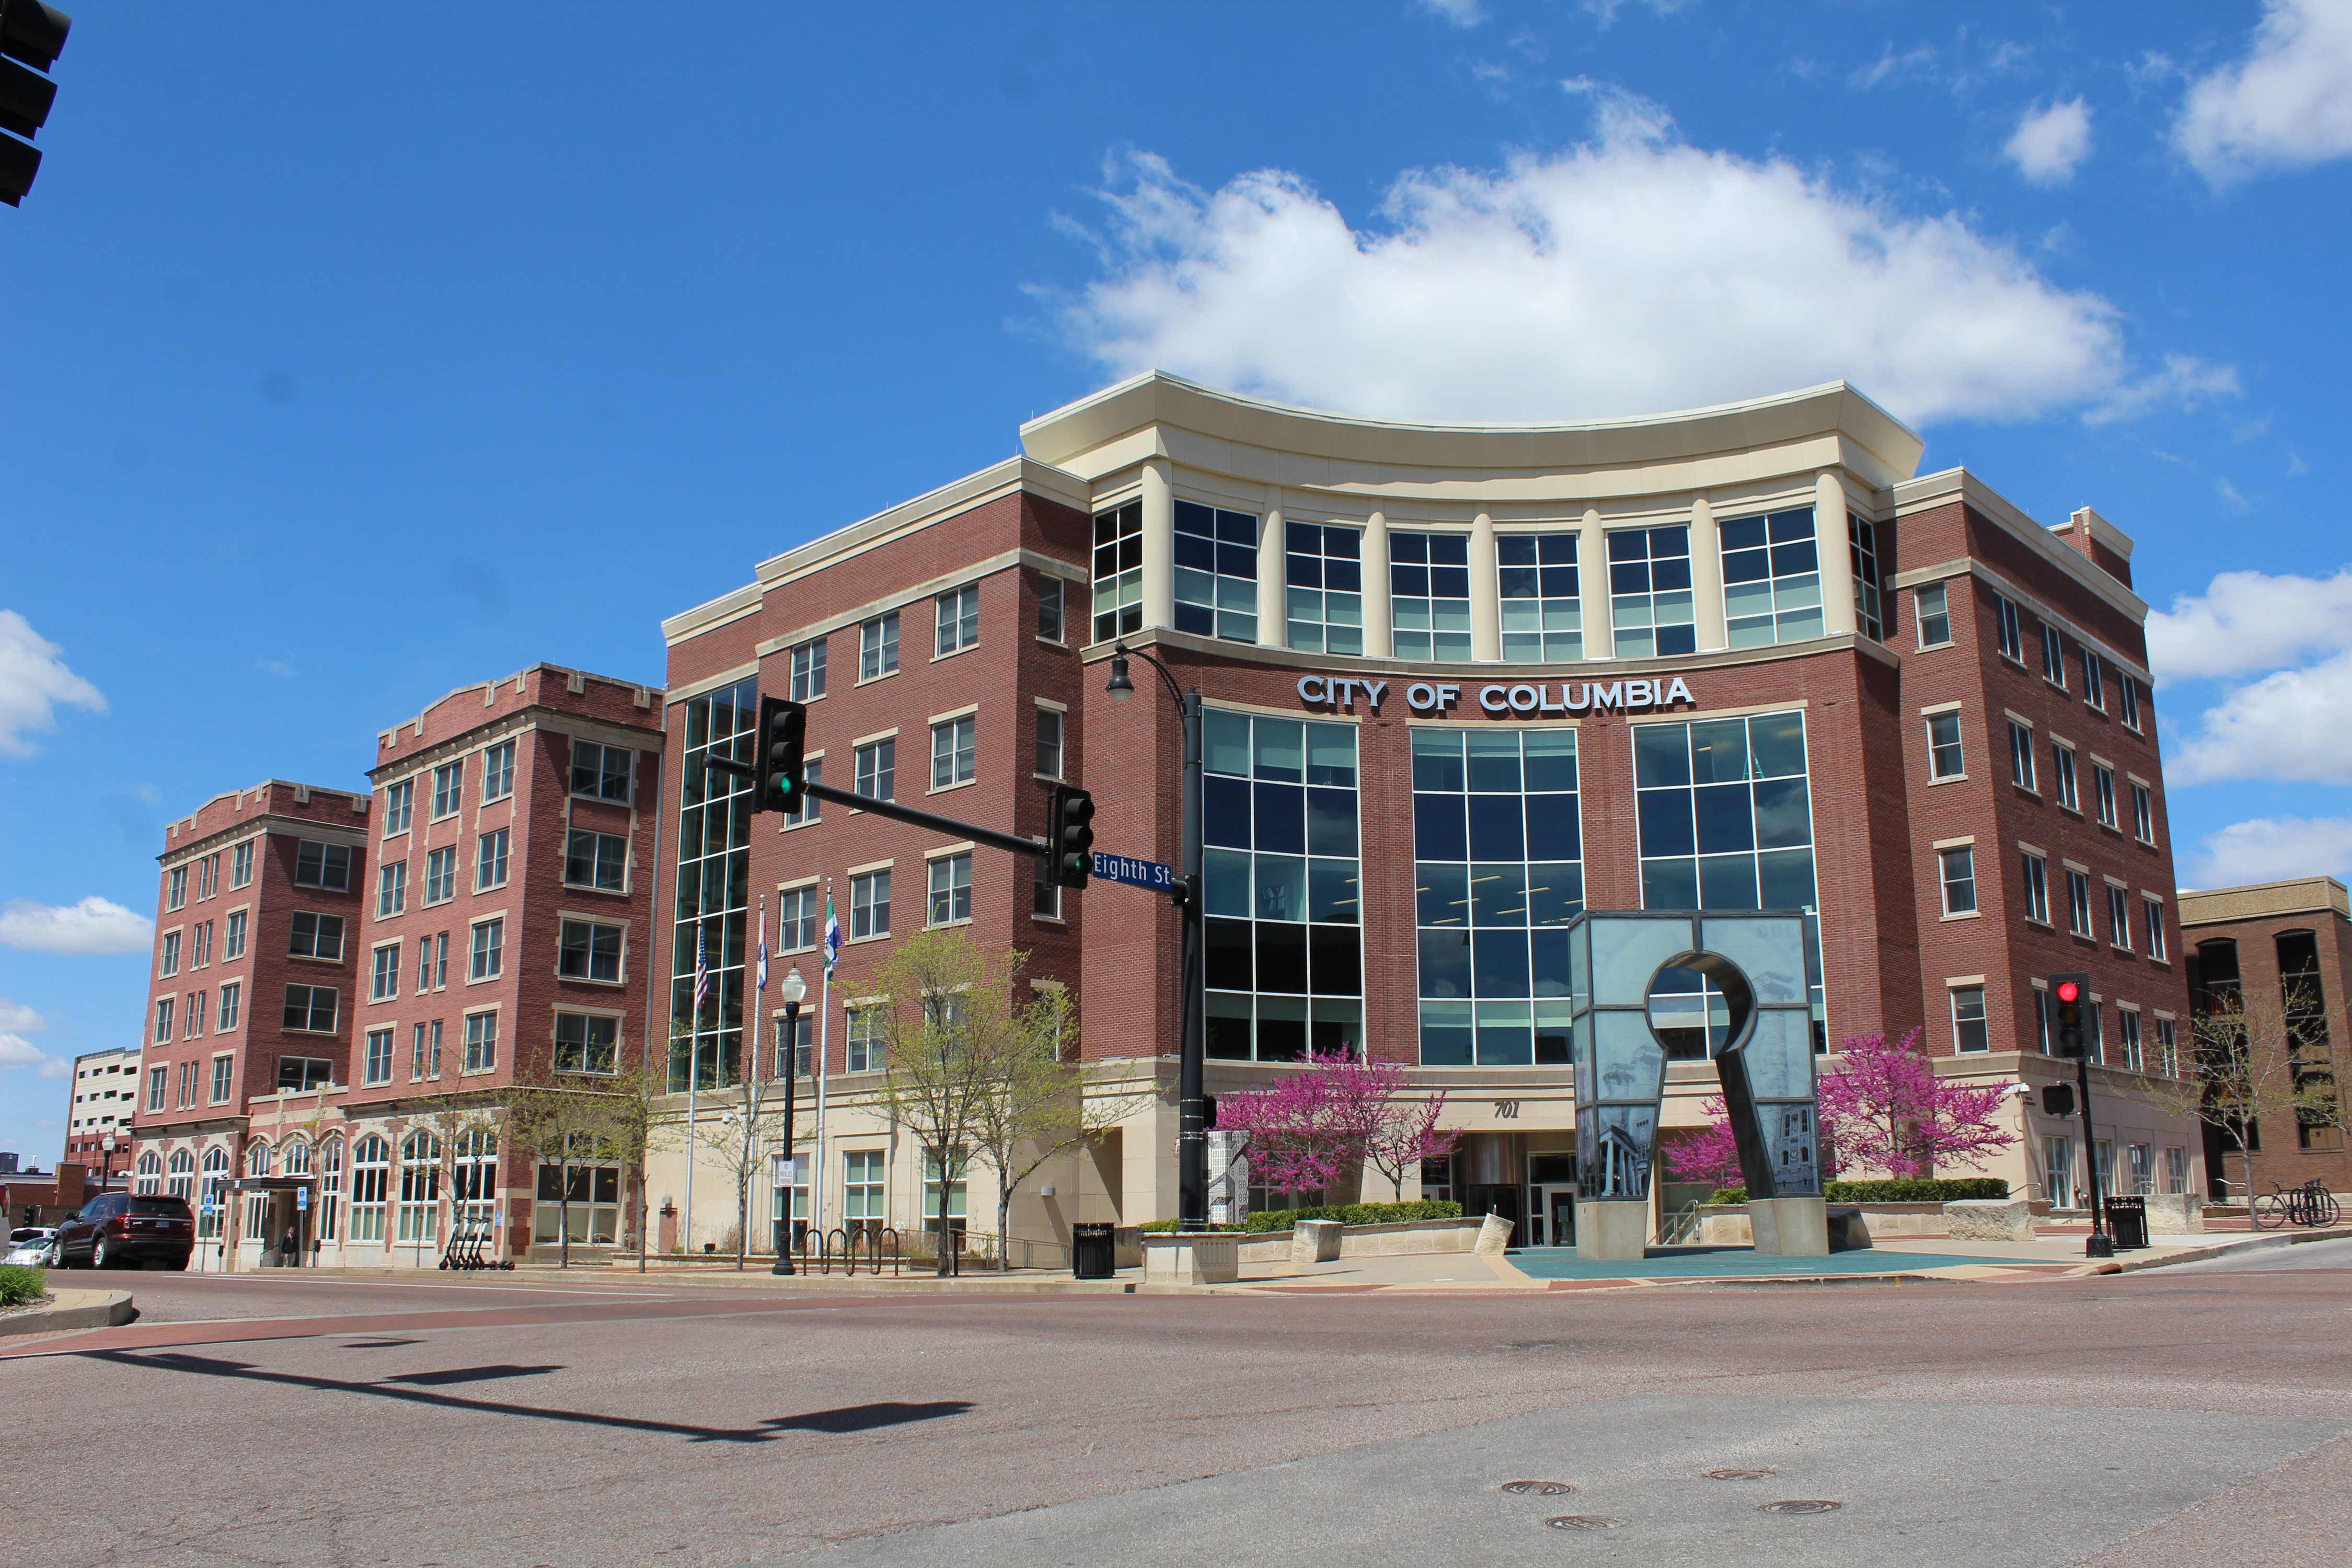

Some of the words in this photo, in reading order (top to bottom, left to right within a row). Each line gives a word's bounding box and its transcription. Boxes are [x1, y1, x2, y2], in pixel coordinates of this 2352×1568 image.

[1297, 675, 1387, 707] CITY
[1406, 683, 1460, 710] OF
[1479, 677, 1696, 711] COLUMBIA
[1094, 854, 1147, 881] Eighth
[1155, 866, 1170, 884] St
[1495, 1101, 1519, 1119] 701
